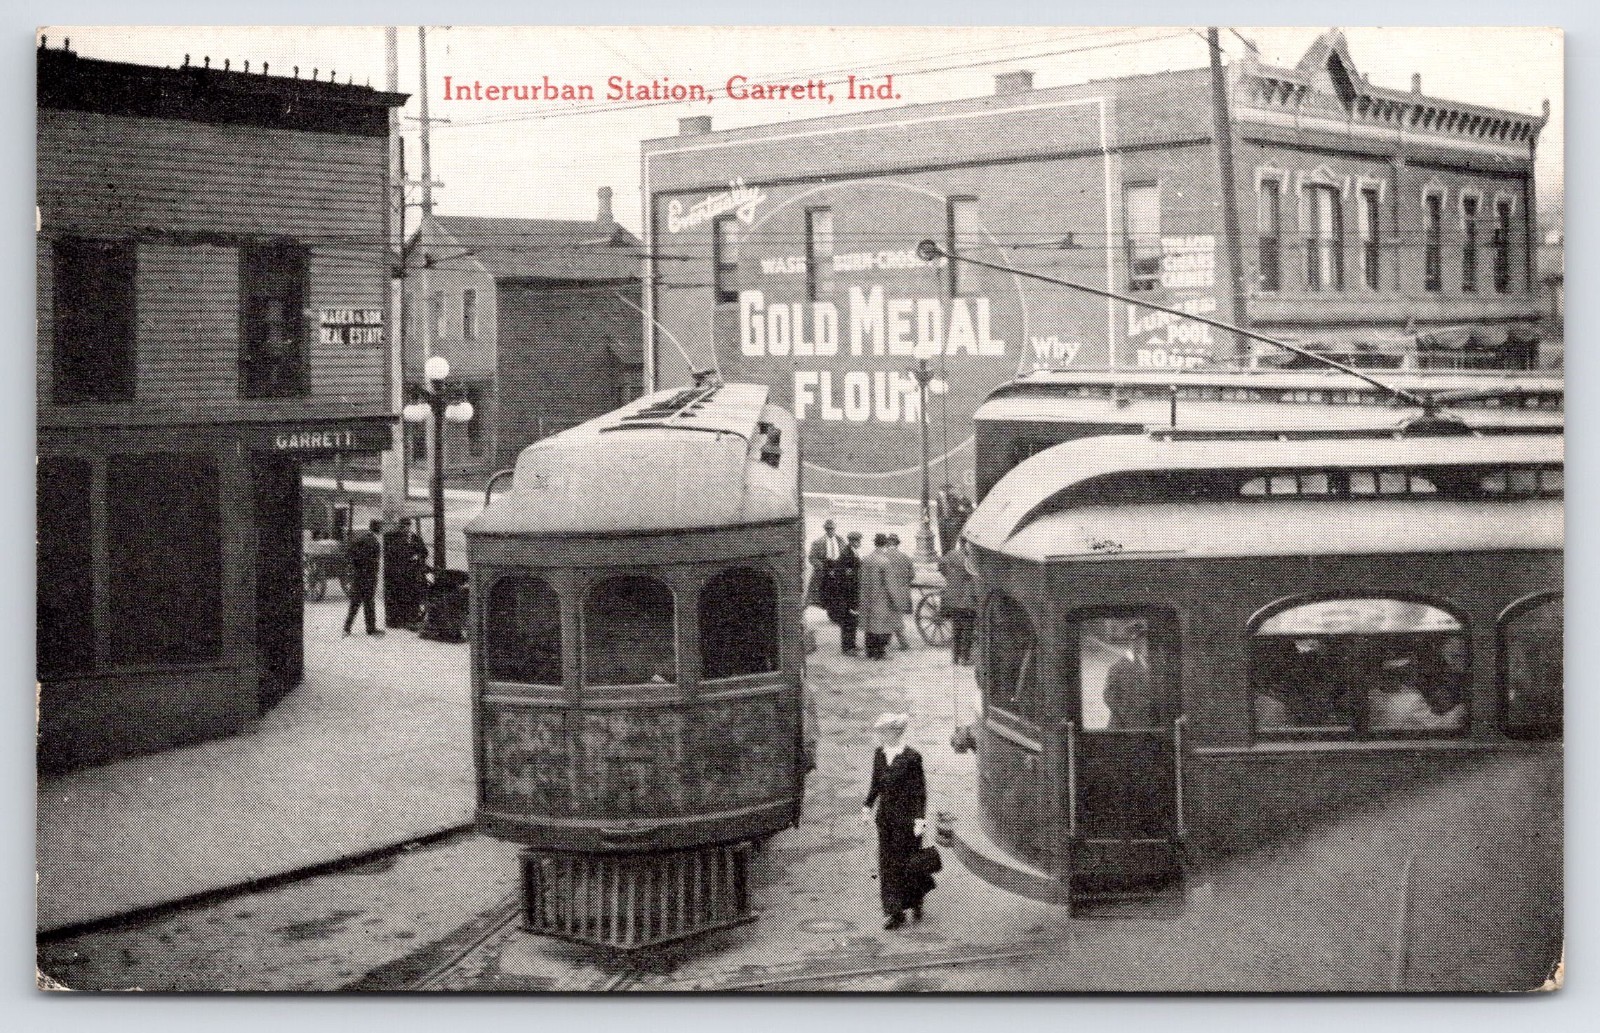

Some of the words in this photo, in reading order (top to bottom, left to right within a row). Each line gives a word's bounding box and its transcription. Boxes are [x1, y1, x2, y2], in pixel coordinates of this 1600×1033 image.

[738, 288, 838, 357] GOLD
[848, 283, 1006, 357] MEDAL
[349, 327, 383, 345] ESTATE
[1167, 323, 1213, 345] POOL
[1029, 335, 1082, 367] Why
[275, 430, 352, 450] GARRETT
